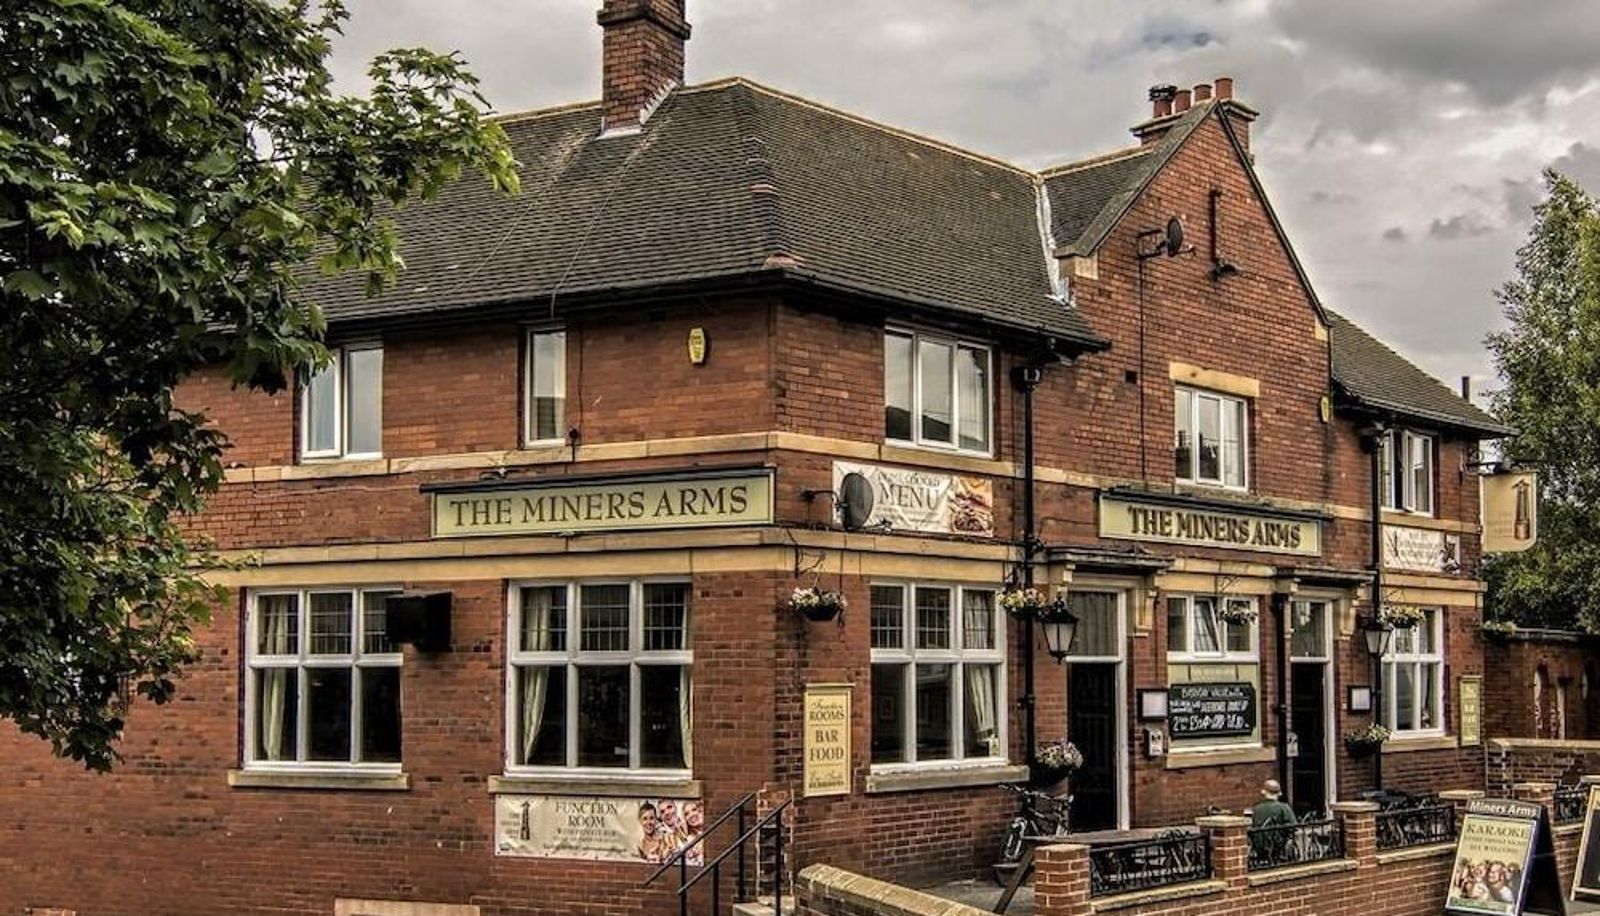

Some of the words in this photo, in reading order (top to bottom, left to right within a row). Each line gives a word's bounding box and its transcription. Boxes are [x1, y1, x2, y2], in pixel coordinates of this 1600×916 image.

[879, 481, 940, 511] MENU
[450, 497, 512, 527] THE
[520, 490, 645, 524] MINERS
[653, 485, 748, 516] ARMS
[1128, 505, 1172, 536] THE
[1176, 512, 1249, 544] MINERS
[1251, 521, 1301, 548] ARMS
[809, 709, 845, 722] ROOMS
[815, 729, 839, 744] BAR
[810, 746, 844, 762] FOOD
[555, 801, 618, 815] FUNCTION
[1469, 801, 1506, 814] Miners
[1507, 803, 1538, 817] Arms
[568, 815, 605, 828] ROOM
[1467, 824, 1527, 838] KARAOKE
